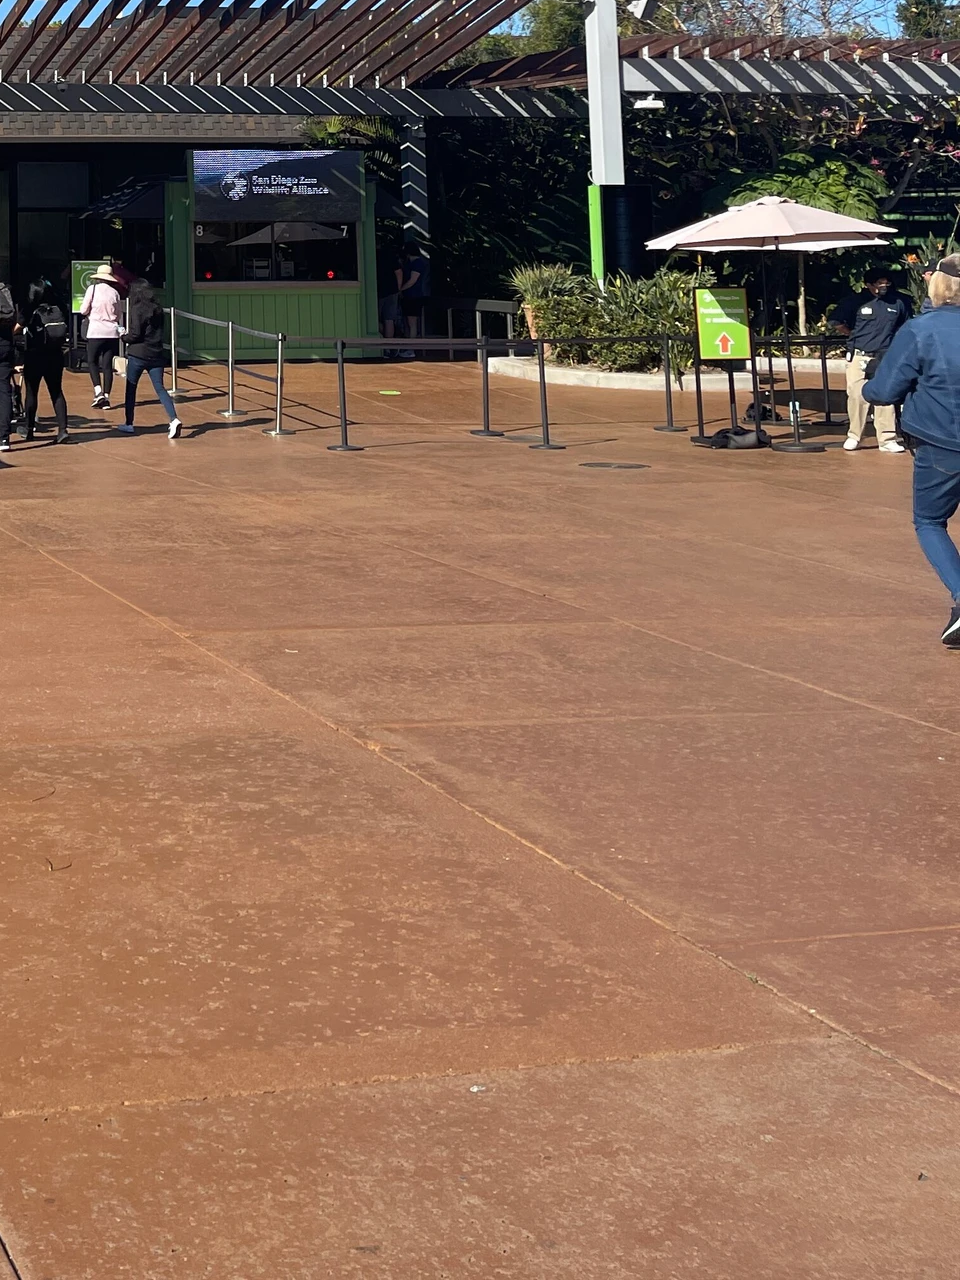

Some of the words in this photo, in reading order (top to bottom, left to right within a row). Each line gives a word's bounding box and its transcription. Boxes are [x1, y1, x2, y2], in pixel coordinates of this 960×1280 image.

[252, 175, 270, 184] San
[271, 174, 298, 187] Diego
[298, 175, 318, 184] Zoo
[291, 185, 330, 195] Alliance
[195, 225, 204, 236] 8
[340, 225, 348, 236] 7
